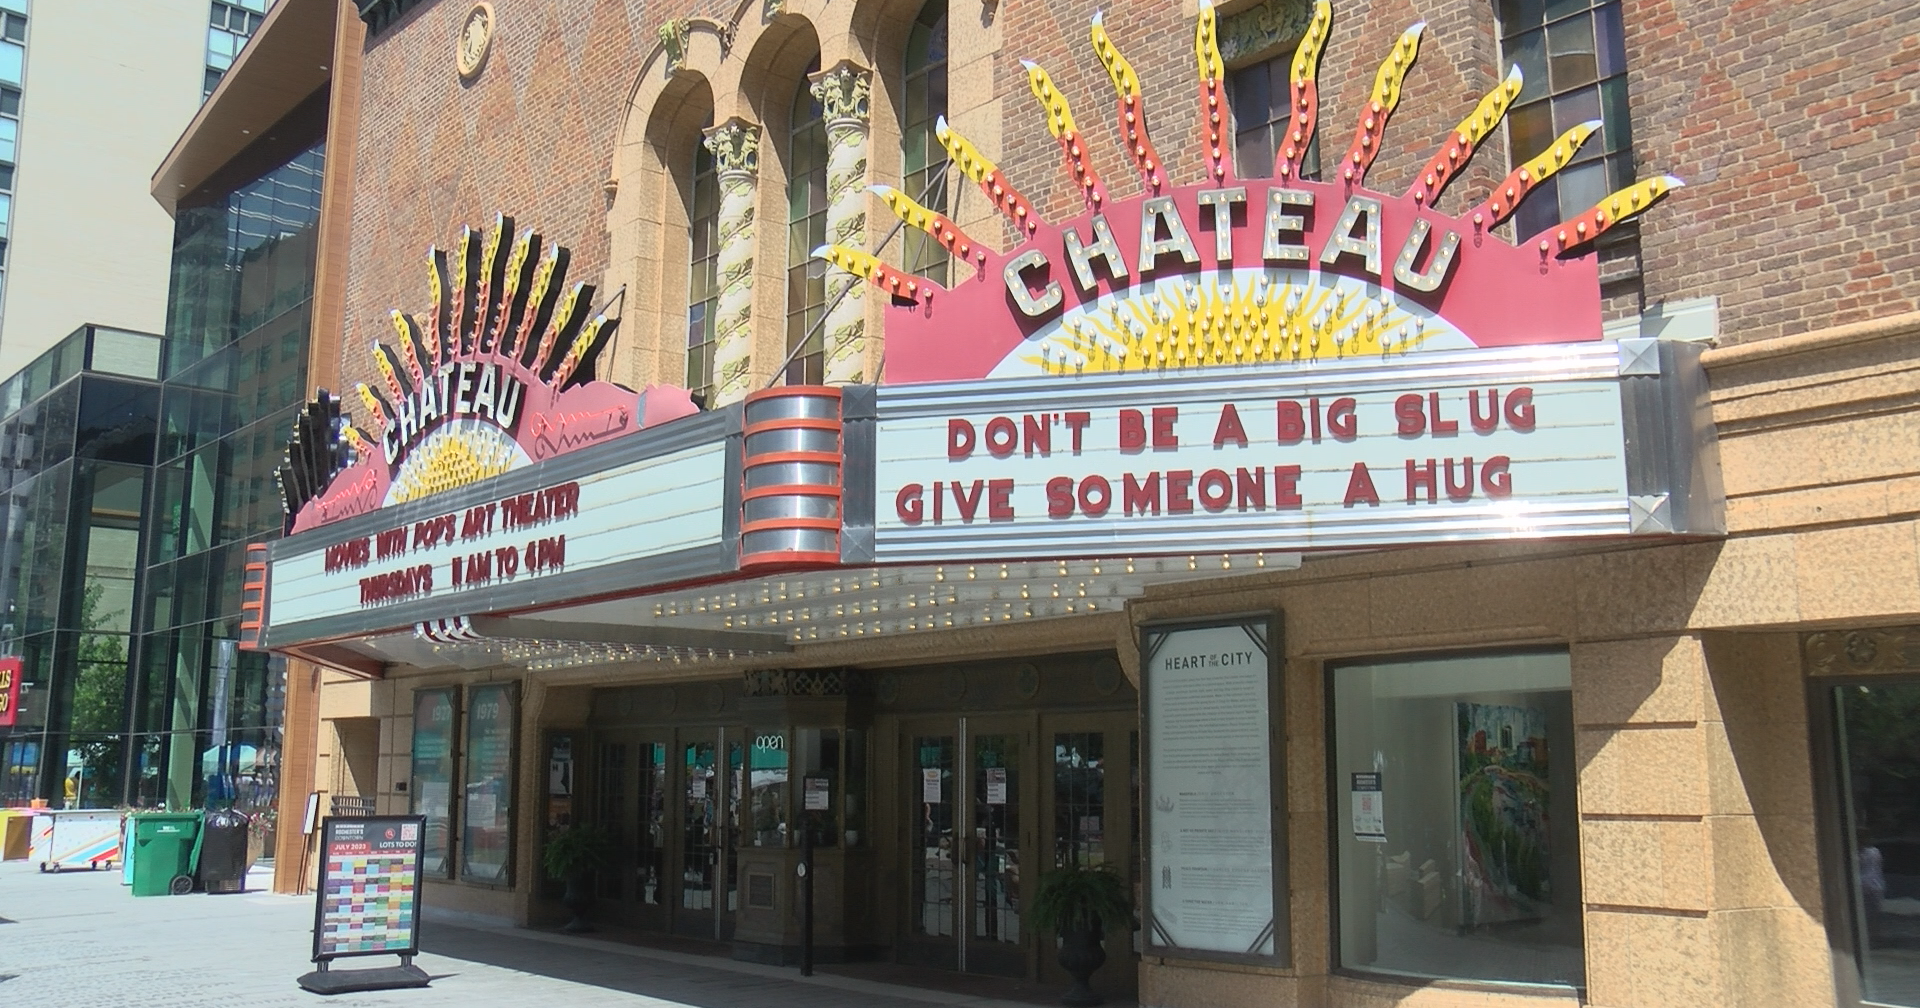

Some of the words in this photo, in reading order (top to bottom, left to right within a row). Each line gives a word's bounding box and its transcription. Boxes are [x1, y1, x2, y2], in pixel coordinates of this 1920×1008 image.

[1003, 186, 1461, 317] CHATEAU
[382, 361, 521, 465] CHATEAU
[947, 411, 1091, 460] DON'T
[1119, 407, 1179, 450] BE
[1213, 403, 1248, 447] A
[1277, 397, 1358, 445] BIG
[1394, 387, 1537, 439] SLUG
[895, 479, 1015, 527] GIVE
[1047, 464, 1303, 518] SOMEONE
[1344, 462, 1380, 508] A
[1405, 455, 1512, 502] HUG
[325, 537, 371, 573] MOVIES
[376, 526, 408, 560] WITH
[413, 514, 456, 550] POP'S
[461, 503, 496, 539] ART
[501, 481, 580, 530] THEATER
[359, 564, 433, 605] THURSDAYS
[466, 550, 492, 584] AM
[496, 546, 519, 578] TO
[1165, 655, 1207, 670] HEART
[1221, 652, 1253, 666] CITY
[477, 702, 499, 720] 1979
[756, 735, 783, 753] open
